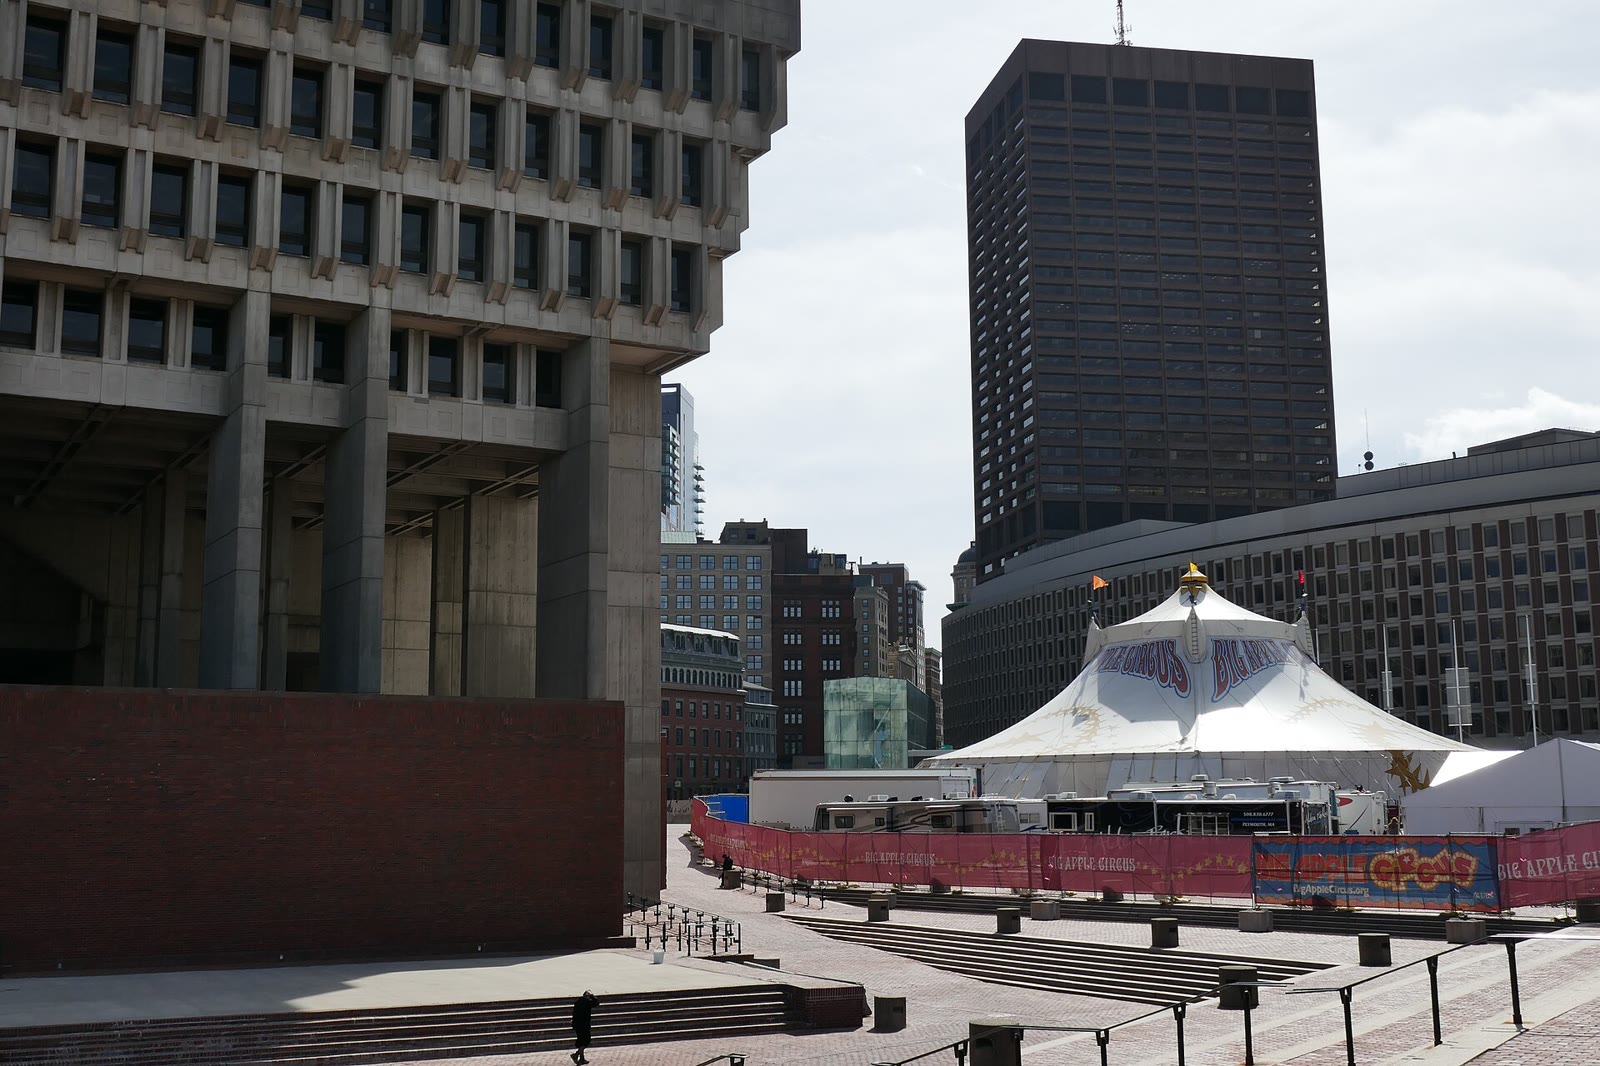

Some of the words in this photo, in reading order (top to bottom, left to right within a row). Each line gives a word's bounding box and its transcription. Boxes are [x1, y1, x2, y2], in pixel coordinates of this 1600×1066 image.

[1121, 639, 1190, 698] CIRCUS
[1211, 639, 1251, 702] BIG
[865, 852, 878, 864] BIG
[880, 852, 905, 866] APPLE
[907, 853, 936, 867] CIRCUS
[1065, 857, 1096, 871] APPLE
[1099, 857, 1136, 872] CIRCUS
[1255, 853, 1291, 882] BIG
[1294, 853, 1368, 883] APPLE
[1369, 847, 1478, 892] CIRCUS
[1498, 862, 1523, 880] BIG
[1526, 854, 1579, 878] APPLE
[1293, 884, 1369, 897] BigAppleCircus.org
